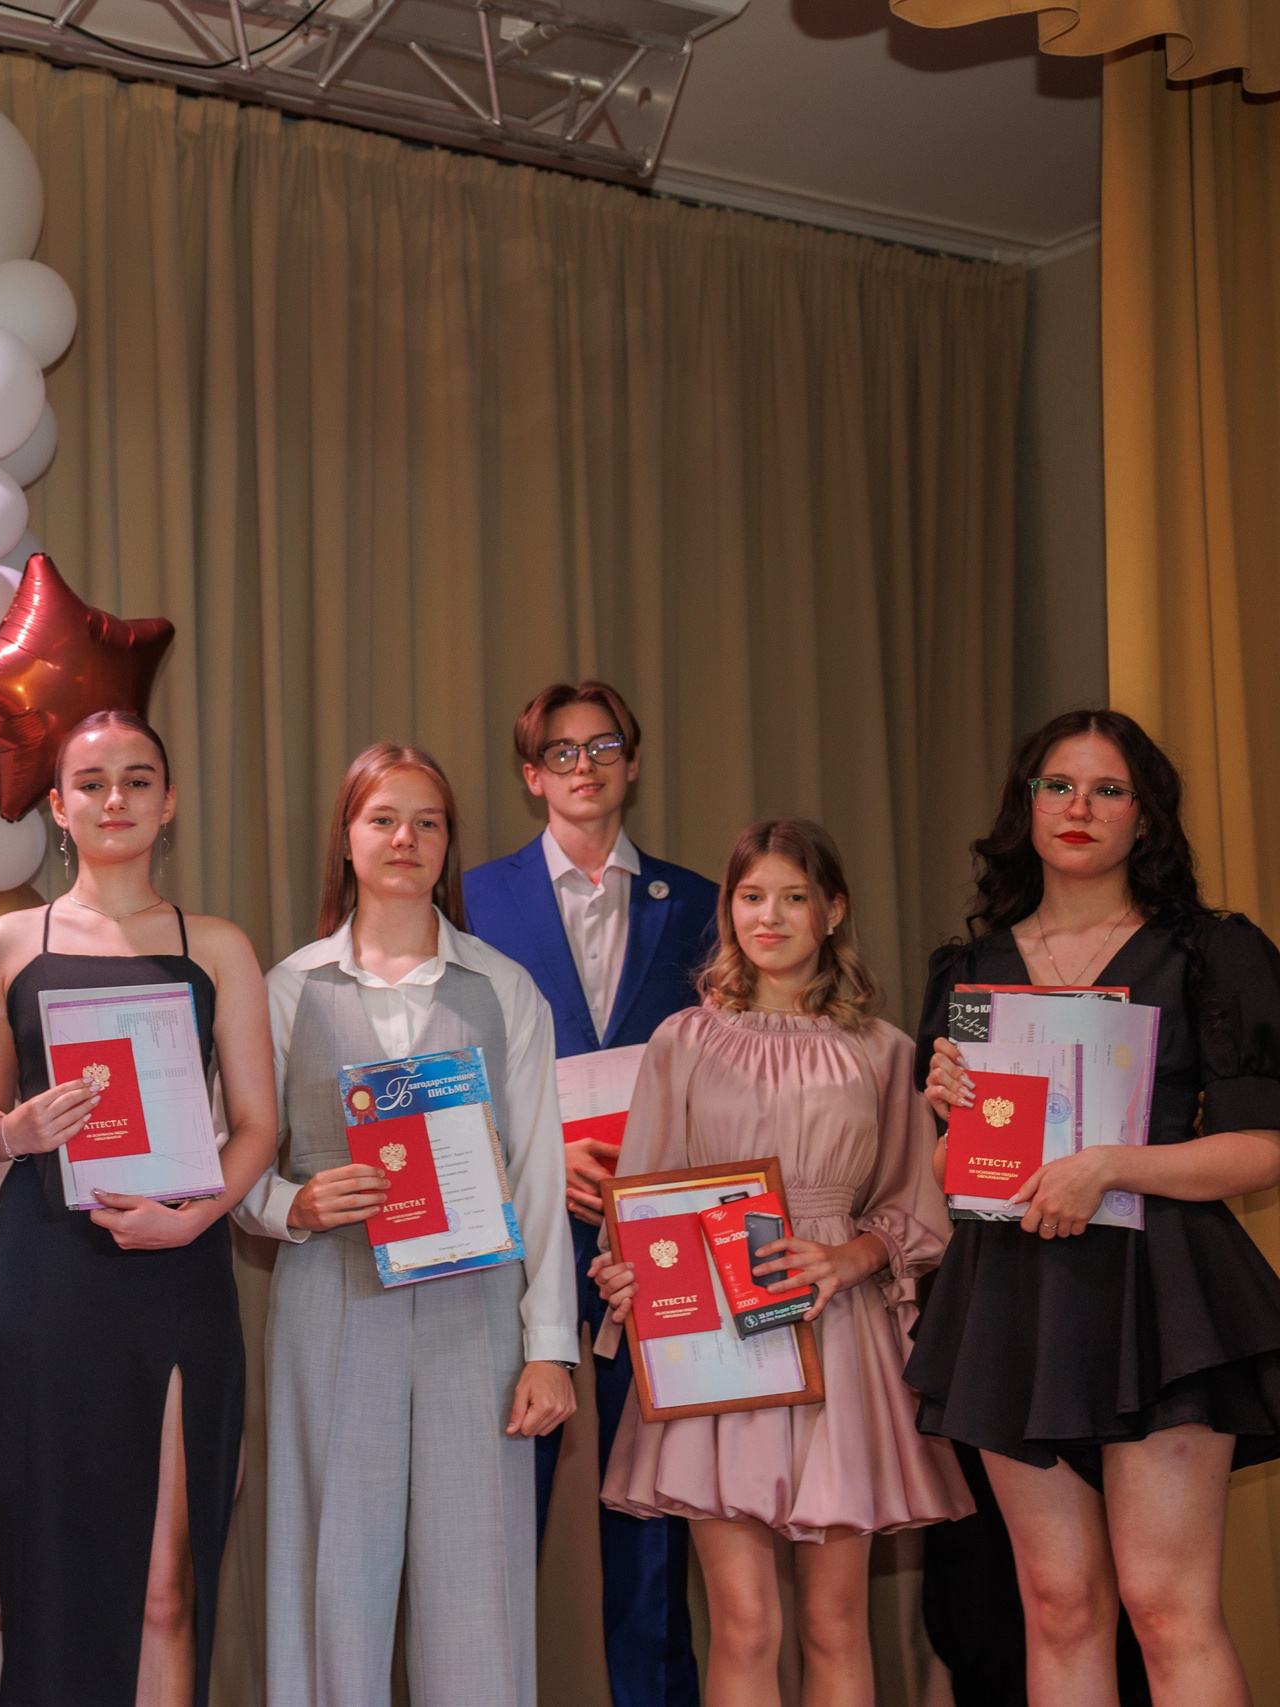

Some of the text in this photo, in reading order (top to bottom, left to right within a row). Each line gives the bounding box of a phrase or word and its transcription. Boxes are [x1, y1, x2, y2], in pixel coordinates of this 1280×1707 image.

[375, 1073, 476, 1111] Благодарственное
[427, 1083, 470, 1098] ПИСЬМО
[83, 1118, 128, 1130] АТТЕСТАТ
[968, 1157, 1021, 1169] АТТЕСТАТ
[382, 1197, 426, 1213] АТТЕСТАТ
[713, 1236, 731, 1246] Star
[651, 1294, 698, 1308] АТТЕСТАТ
